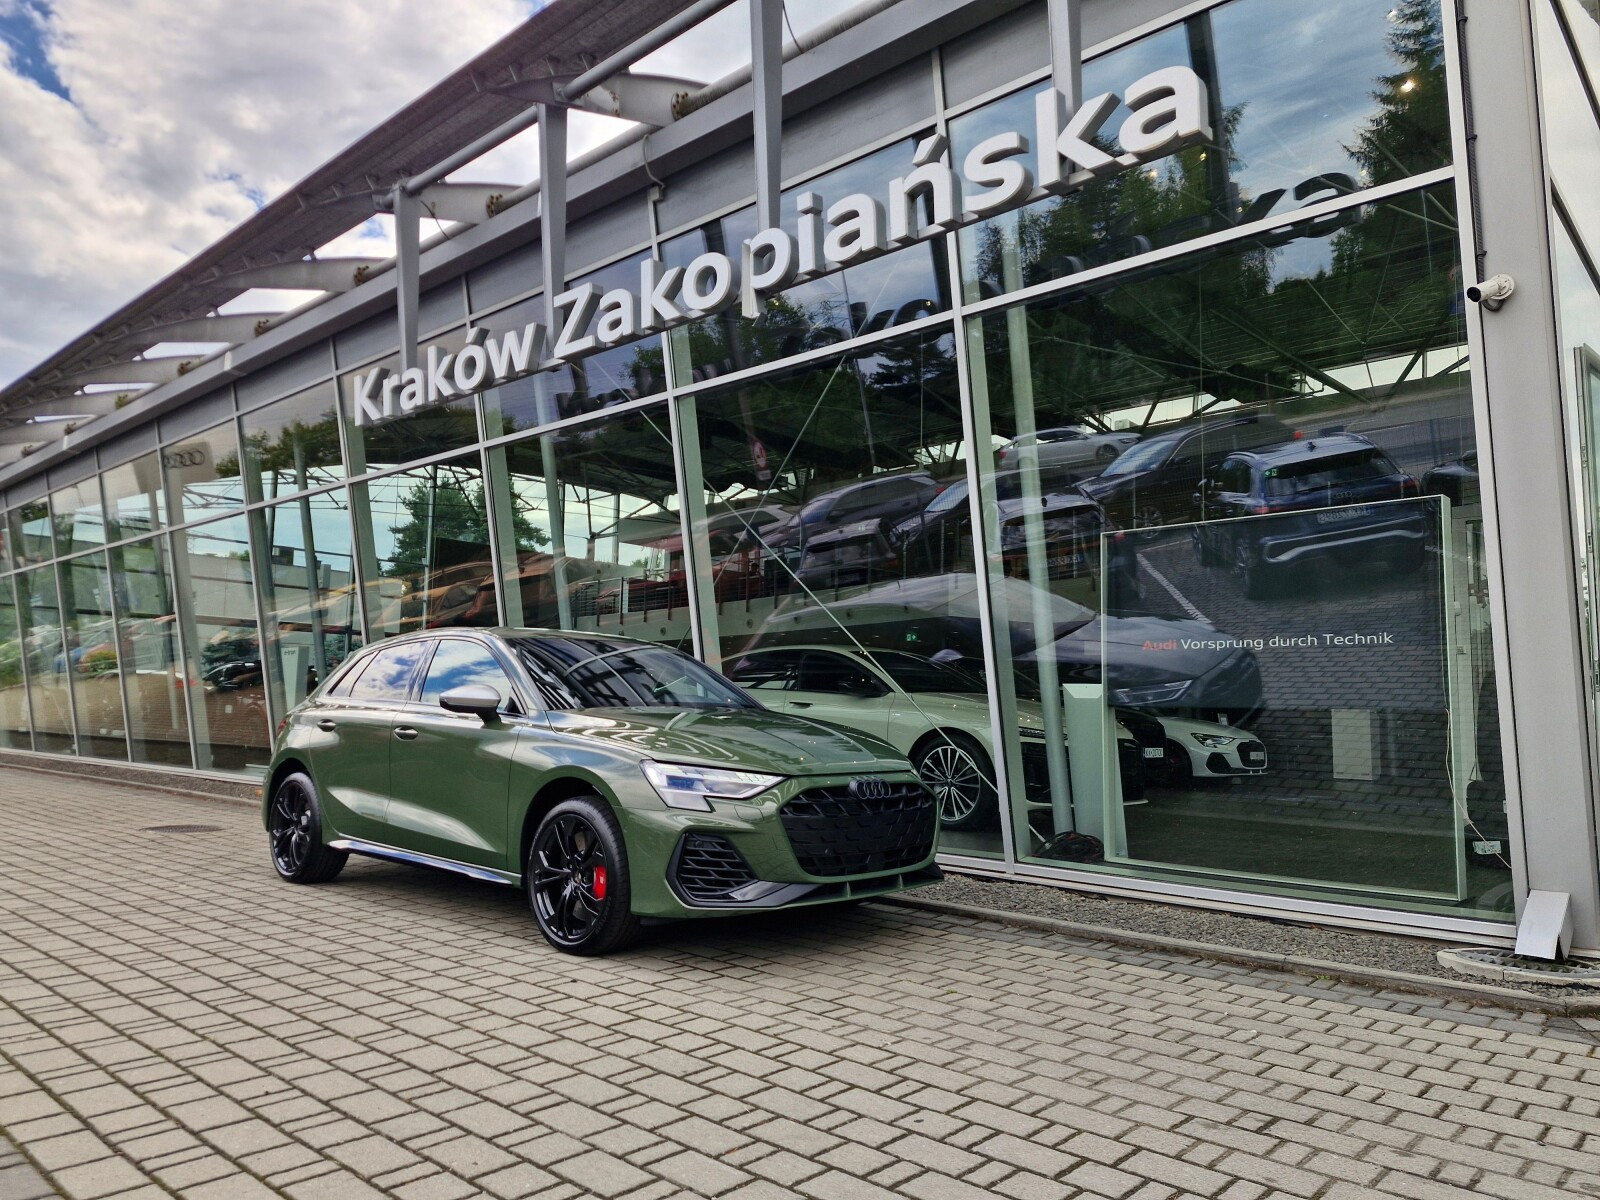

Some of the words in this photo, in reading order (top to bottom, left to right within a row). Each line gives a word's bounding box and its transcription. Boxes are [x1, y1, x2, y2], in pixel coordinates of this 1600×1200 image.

[354, 323, 546, 427] Kraków
[553, 65, 1212, 360] Zakopiańska
[1141, 639, 1177, 652] Audi
[1181, 638, 1263, 652] Vorsprung
[1269, 635, 1318, 647] durch
[1322, 632, 1394, 645] Technik
